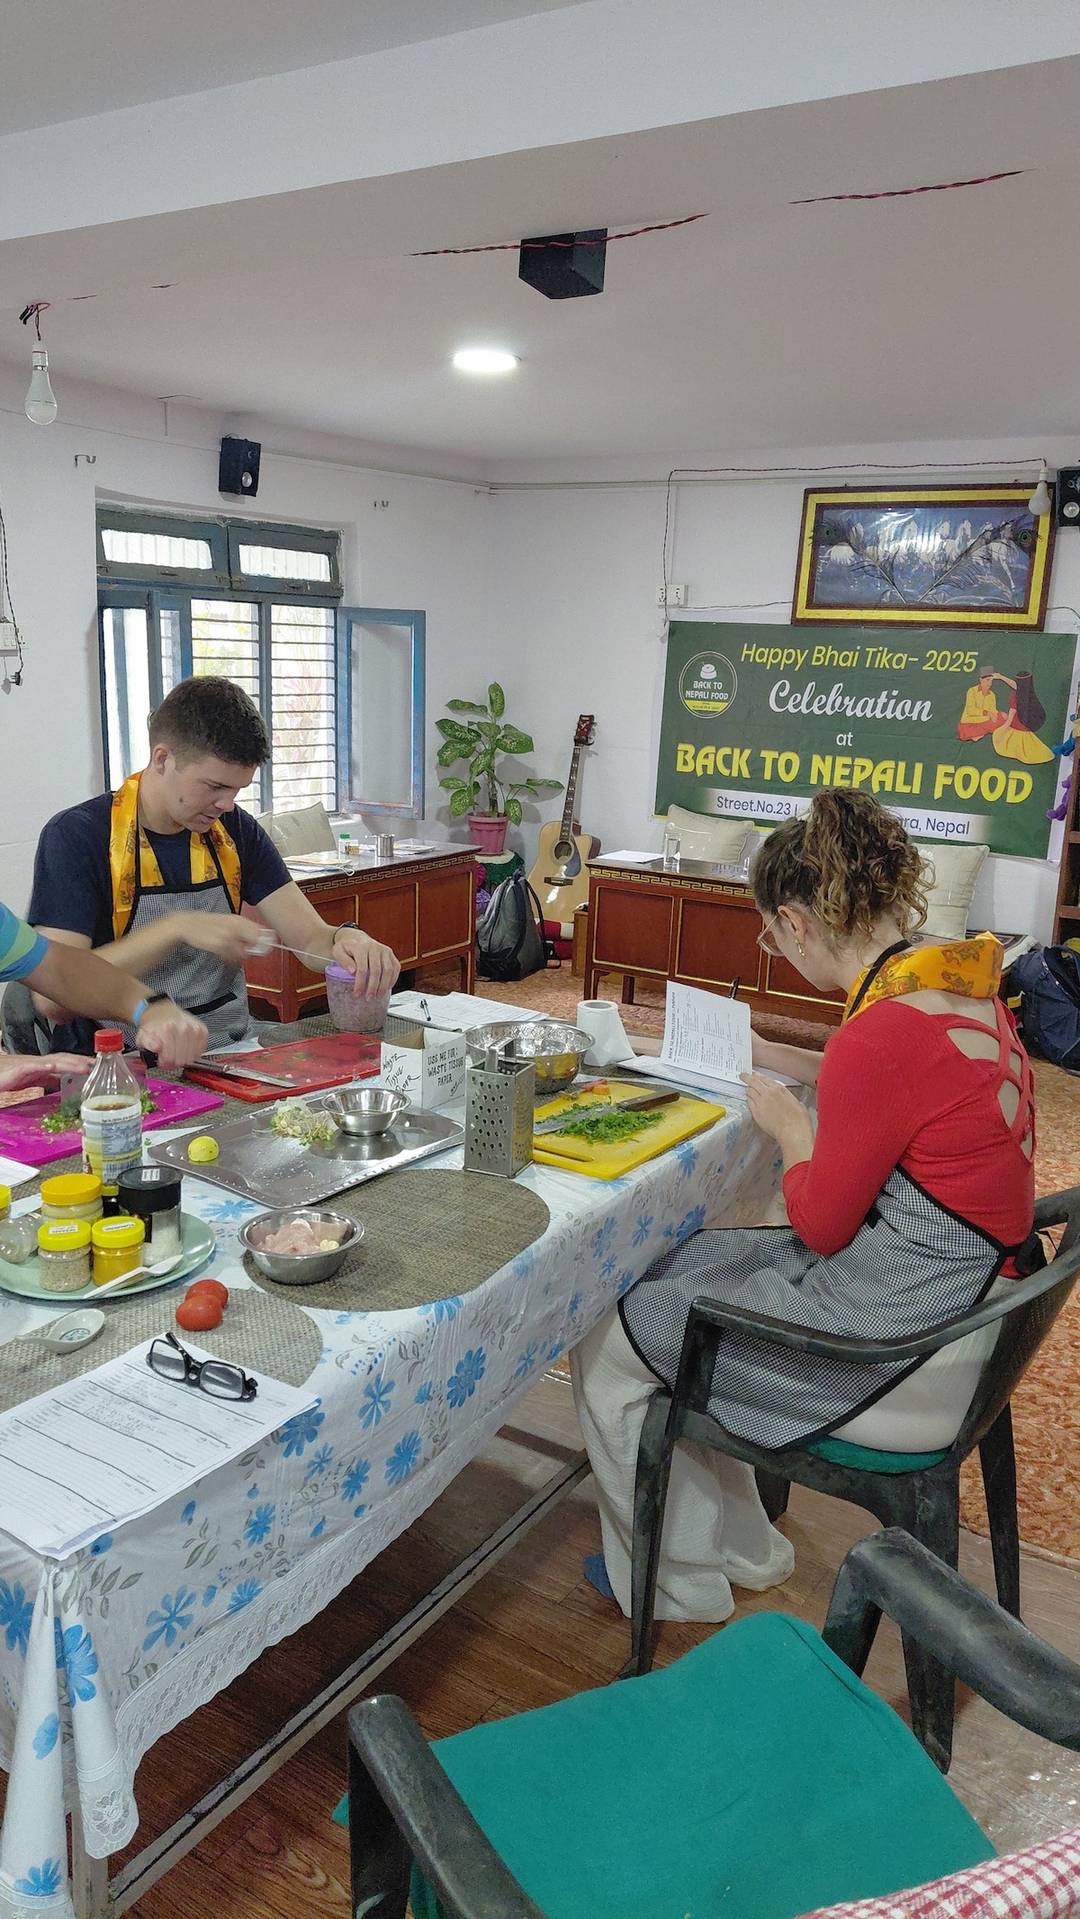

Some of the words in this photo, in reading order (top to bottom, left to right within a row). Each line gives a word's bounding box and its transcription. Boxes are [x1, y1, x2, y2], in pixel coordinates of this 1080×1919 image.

[741, 643, 809, 671] Happy
[811, 645, 861, 668] Bhai
[865, 646, 919, 670] Tika-
[922, 650, 979, 673] 2025
[685, 690, 710, 700] NEPALI
[711, 691, 729, 700] FOOD
[693, 680, 712, 690] BACK
[713, 681, 723, 690] TO
[768, 679, 934, 723] Celebration
[836, 731, 854, 747] at
[676, 743, 752, 779] BACK
[760, 750, 800, 783] TO
[809, 754, 924, 795] NEPALI
[933, 763, 1033, 804] FOOD
[716, 795, 792, 816] Street.No.23
[925, 817, 970, 837] Nepal
